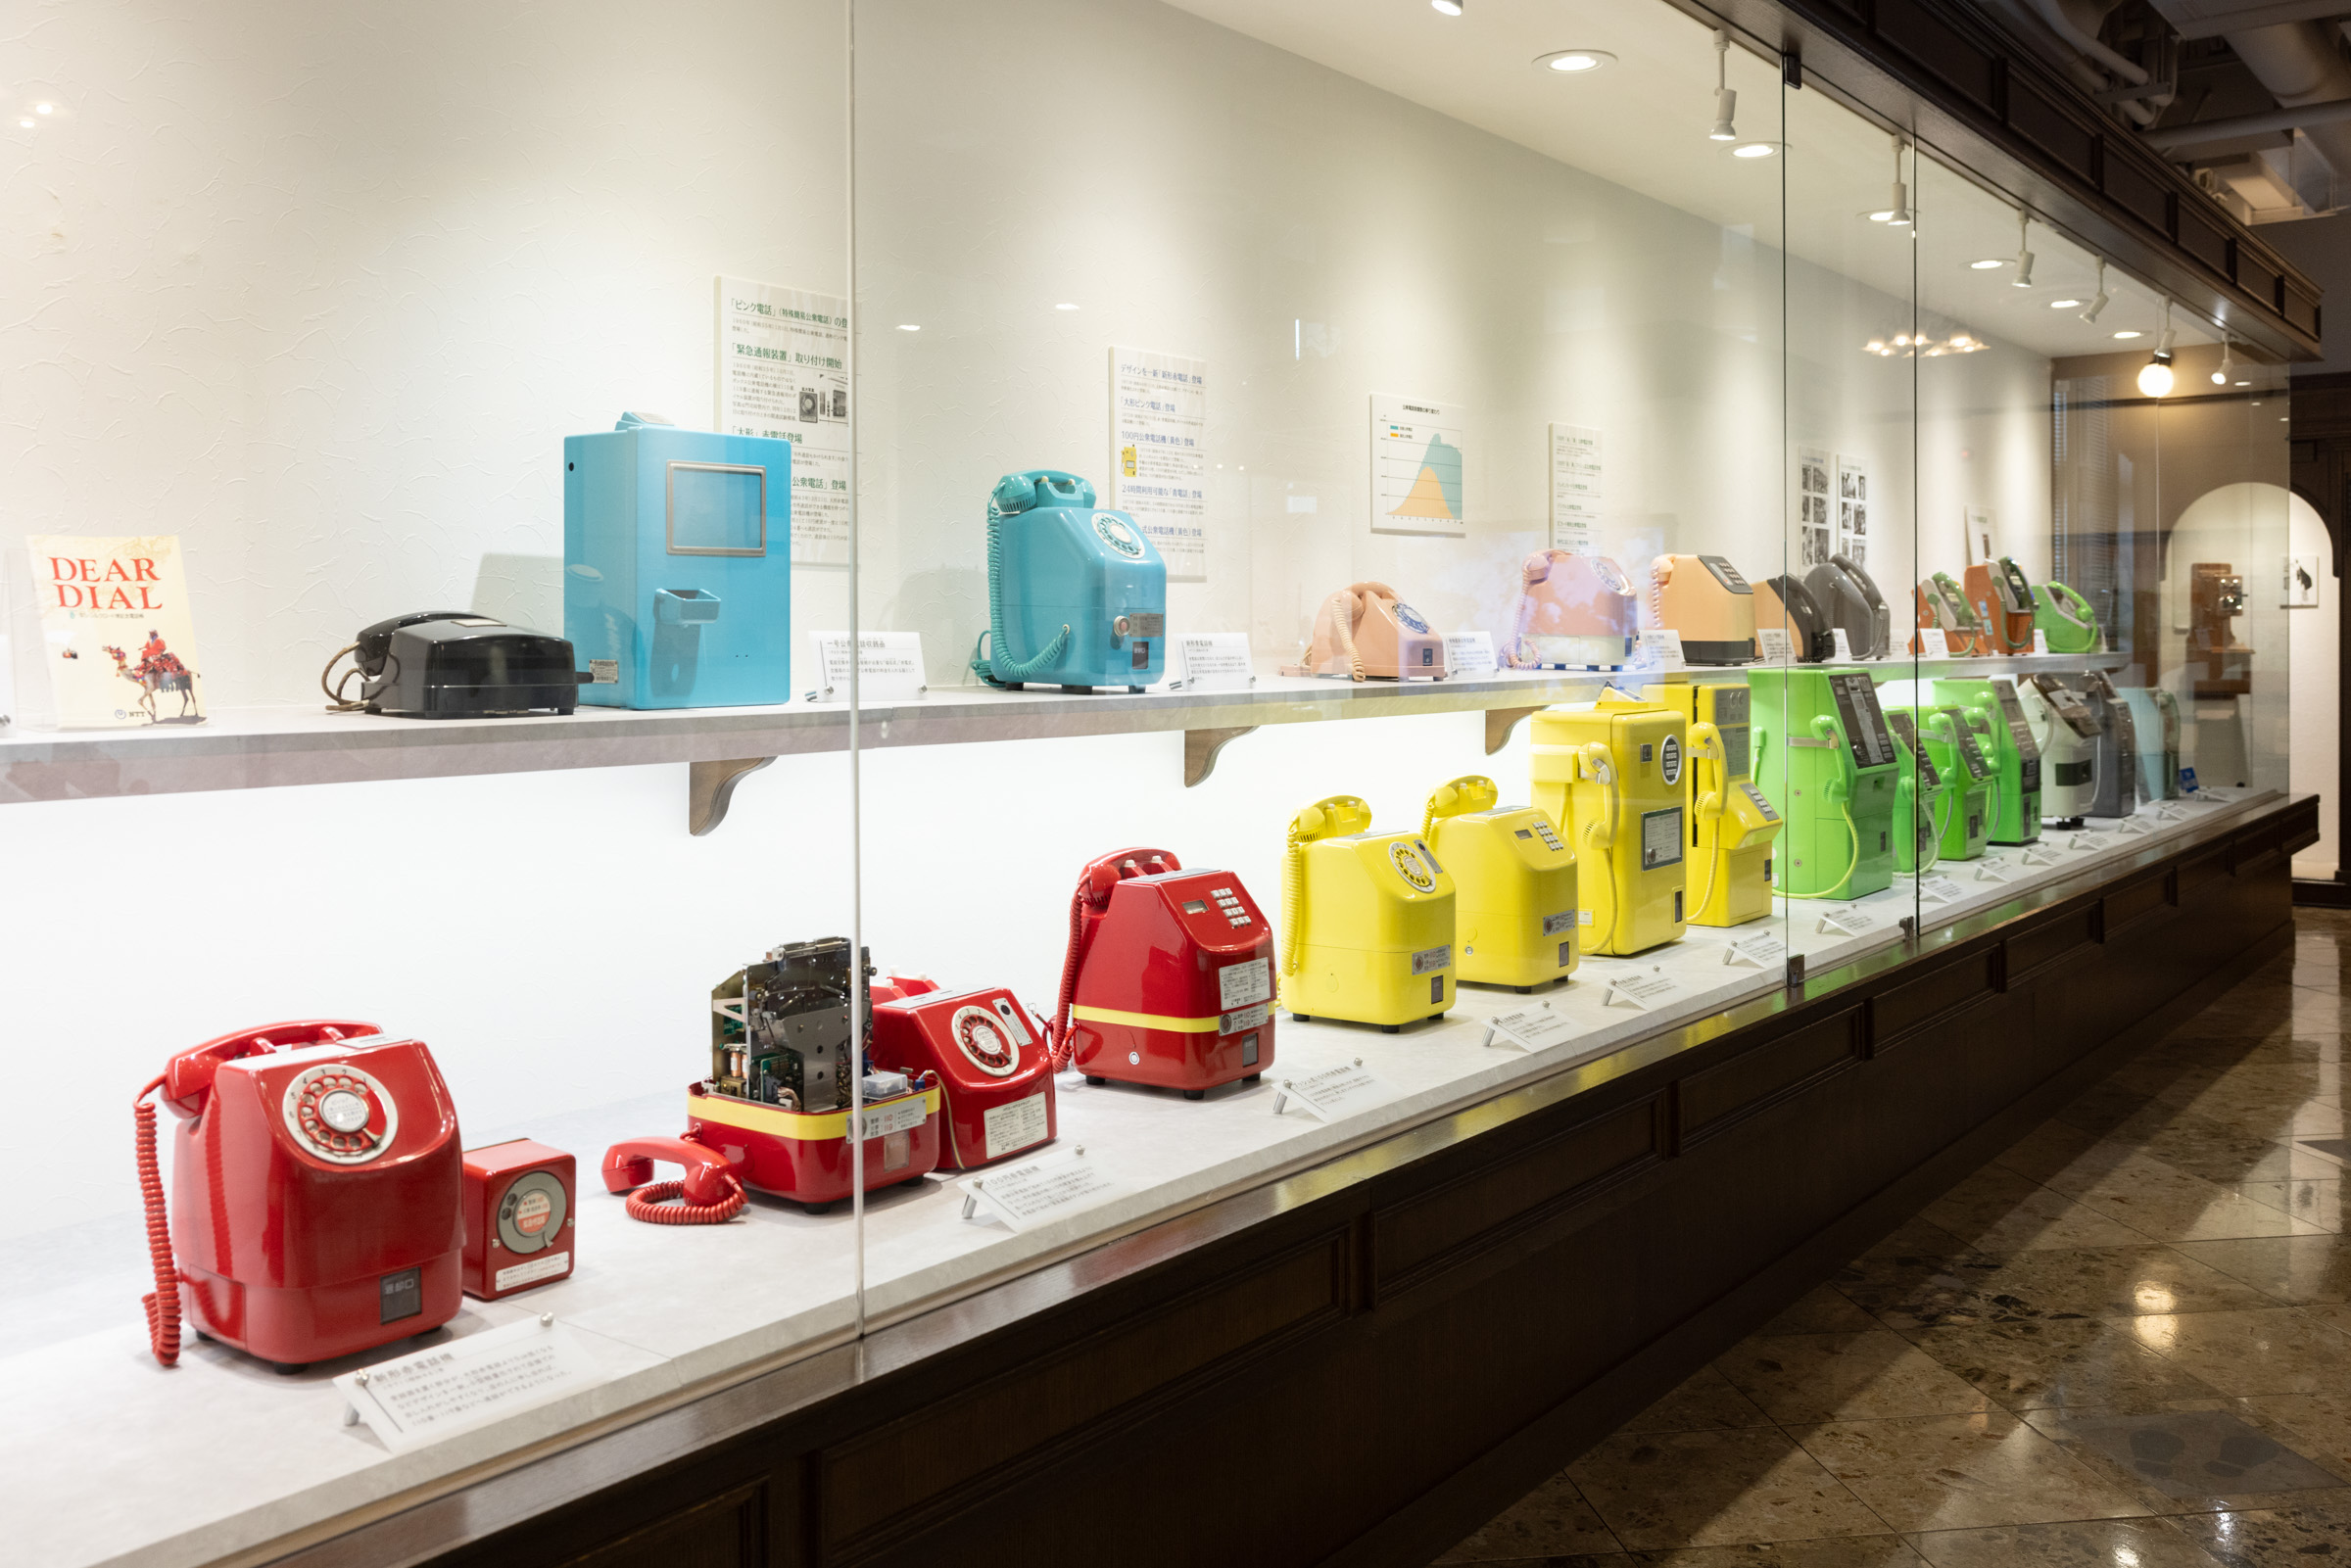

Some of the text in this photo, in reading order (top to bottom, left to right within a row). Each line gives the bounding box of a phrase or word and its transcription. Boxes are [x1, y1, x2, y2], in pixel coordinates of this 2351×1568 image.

[732, 343, 841, 369] 「緊急通報装置」取り付け開始
[1122, 431, 1194, 447] 100円公衆電話機（黄色）登場
[48, 556, 161, 583] DEAR
[53, 584, 163, 610] DIAL
[373, 1353, 455, 1383] 新形赤電話機
